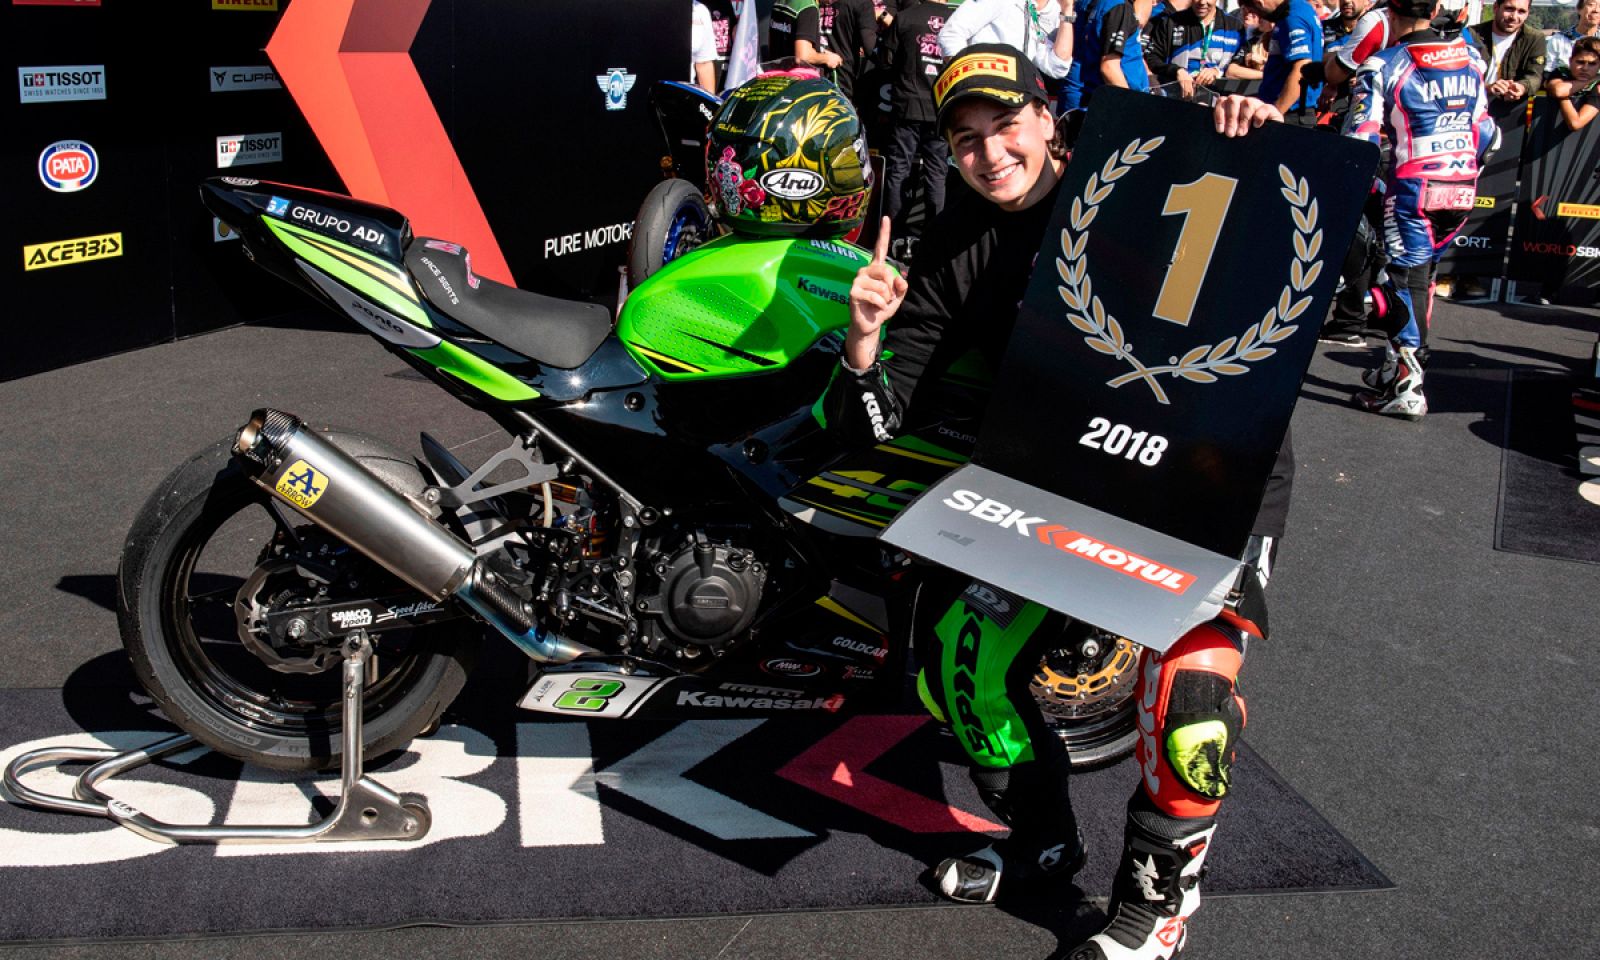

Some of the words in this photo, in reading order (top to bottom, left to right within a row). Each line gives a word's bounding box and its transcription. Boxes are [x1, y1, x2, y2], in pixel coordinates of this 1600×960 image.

[45, 71, 101, 86] TISSOT
[937, 58, 1009, 98] PIRELLI
[1411, 75, 1477, 103] YAMAH
[238, 137, 279, 152] TISSOT
[52, 157, 85, 175] PATA
[766, 173, 816, 190] Arai
[291, 206, 351, 233] GRUPO
[352, 226, 385, 245] ADI
[544, 232, 582, 259] PURE
[1153, 171, 1239, 327] 1
[420, 256, 442, 276] RACE
[1078, 416, 1169, 467] 2018
[277, 483, 313, 508] ARROW
[942, 489, 1048, 537] SBK
[1065, 536, 1187, 590] MOTUL
[331, 608, 371, 622] SAMCO
[832, 635, 889, 659] GOLDCAR
[676, 690, 847, 711] Kawasaki
